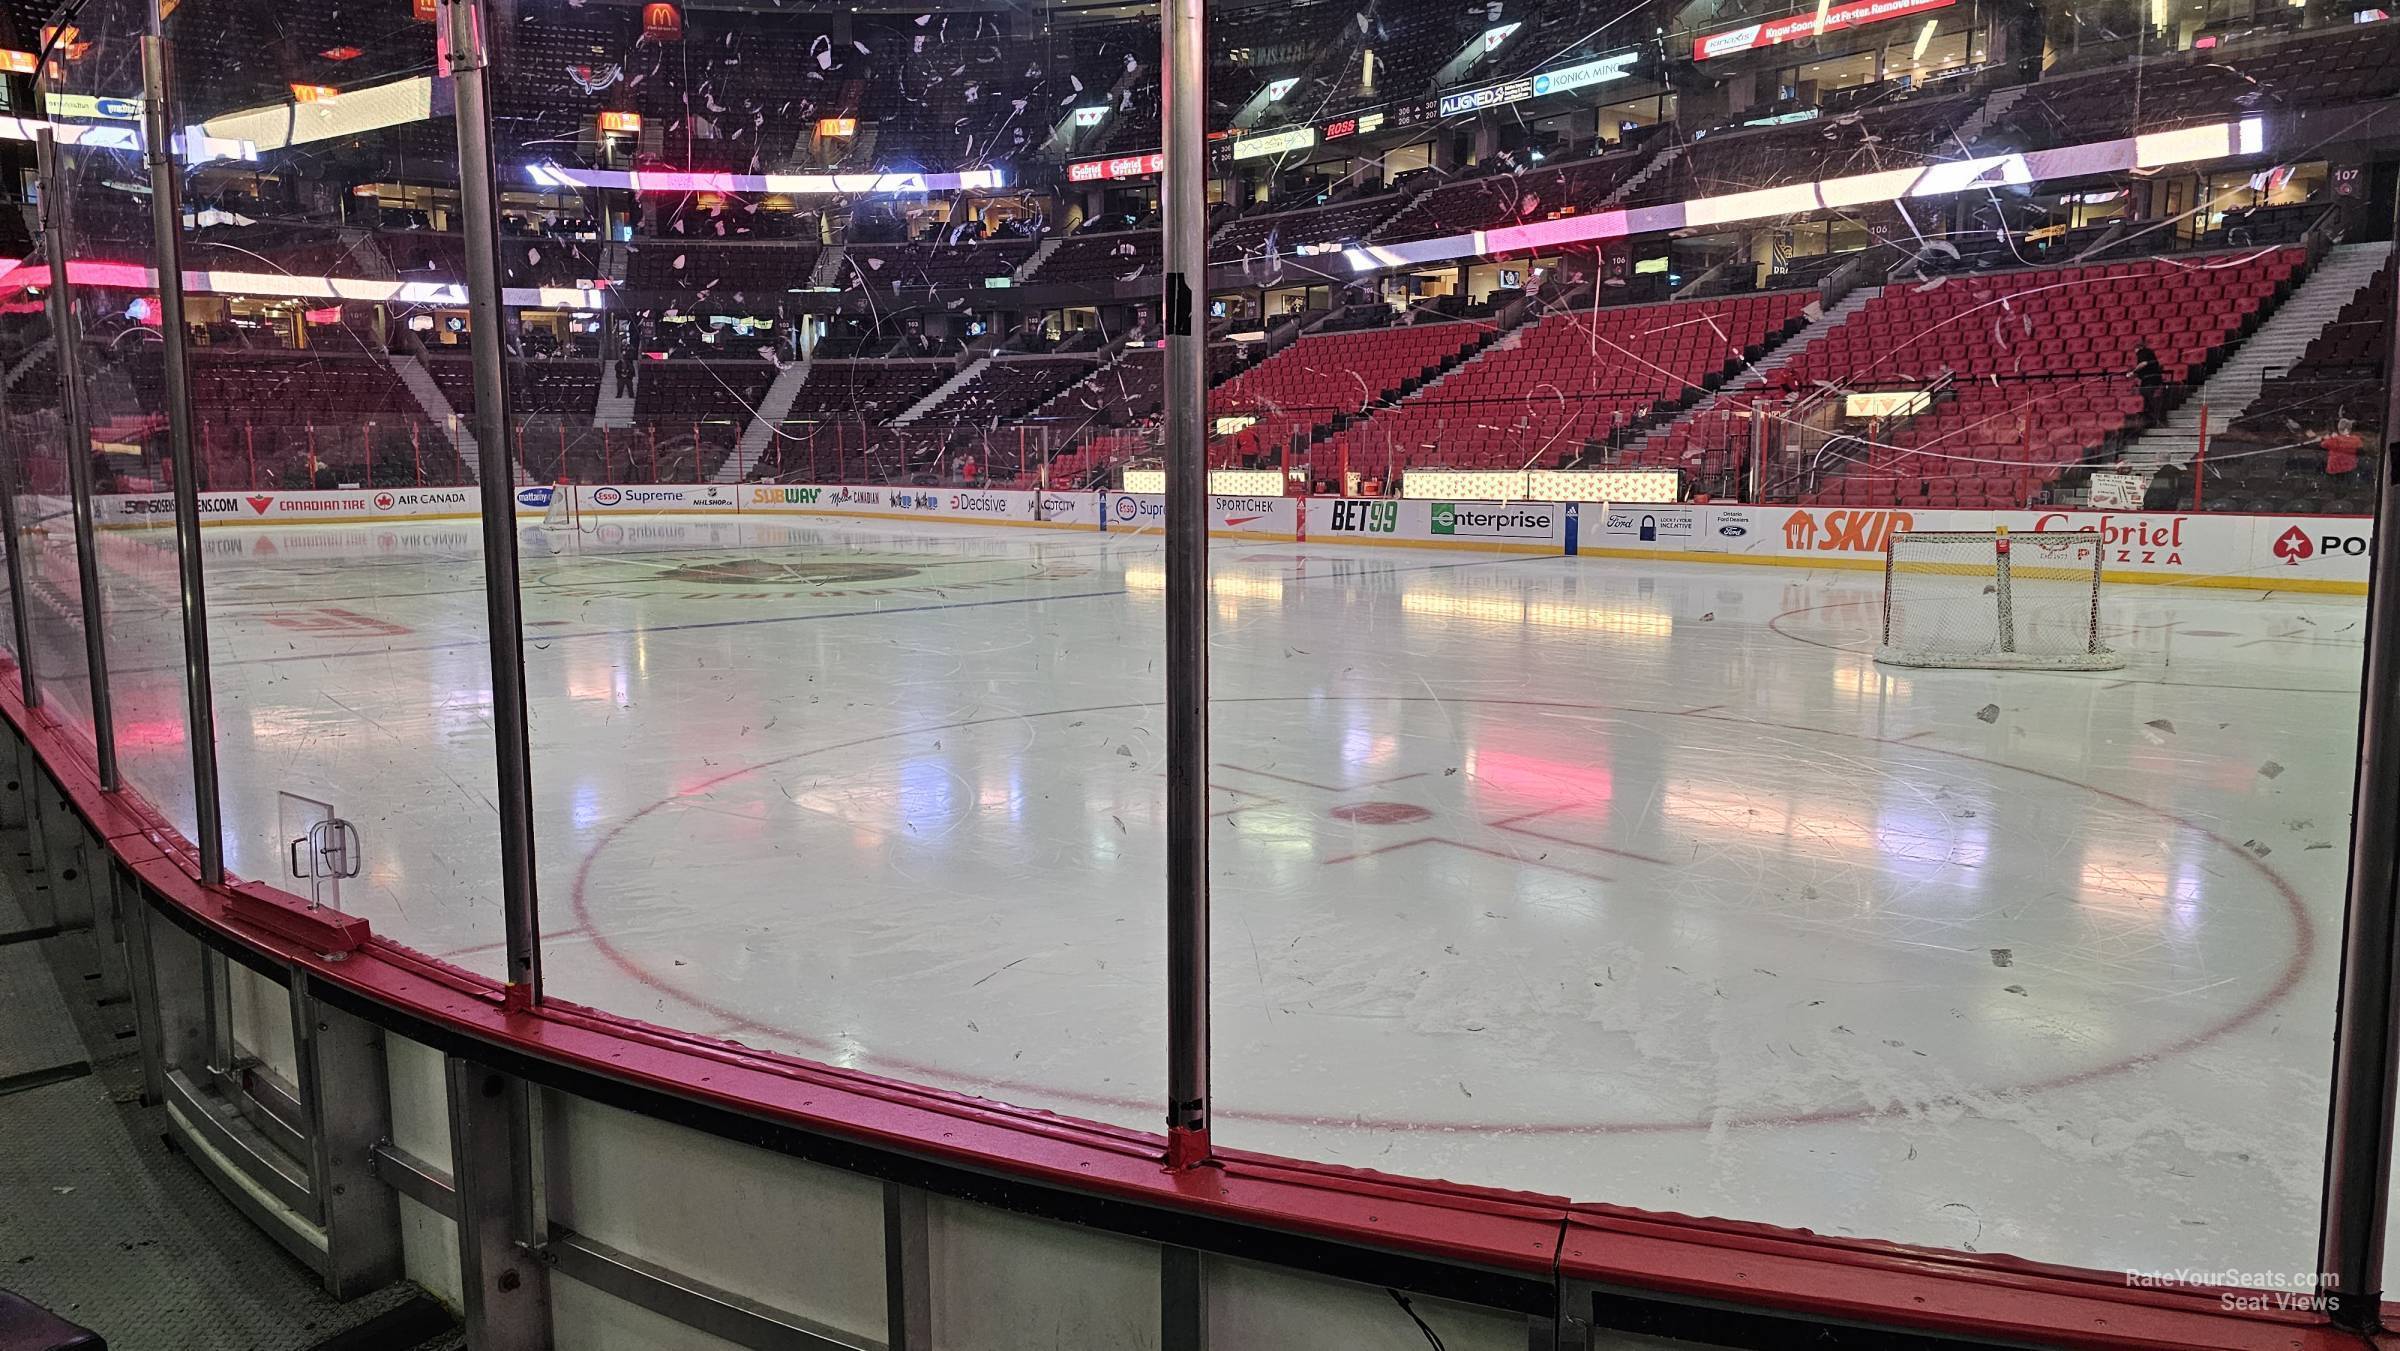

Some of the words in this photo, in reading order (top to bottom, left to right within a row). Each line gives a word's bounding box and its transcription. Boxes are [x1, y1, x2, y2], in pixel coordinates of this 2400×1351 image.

[1765, 24, 1790, 39] Know
[1825, 13, 1841, 25] Act
[1871, 1, 1911, 16] Remove
[1553, 71, 1590, 87] KONICA
[1425, 100, 1438, 110] 307
[1442, 90, 1494, 114] ALIGNED
[1398, 106, 1411, 116] 306
[1425, 110, 1438, 120] 207
[1327, 119, 1356, 137] ROSS
[2335, 169, 2359, 181] 107
[1871, 224, 1888, 235] 106
[1612, 256, 1626, 265] 106
[398, 495, 419, 505] AIR
[420, 493, 466, 505] CANADA
[625, 489, 683, 504] Supreme
[752, 488, 822, 504] SUBWAY
[853, 491, 880, 504] CANADIAN
[961, 493, 1006, 512] Decisive
[279, 500, 340, 512] CANADIAN
[342, 499, 366, 511] TIRE
[1331, 500, 1398, 533] BET99
[1437, 510, 1551, 531] enterprise
[1606, 514, 1633, 529] Ford
[2321, 535, 2374, 557] PO
